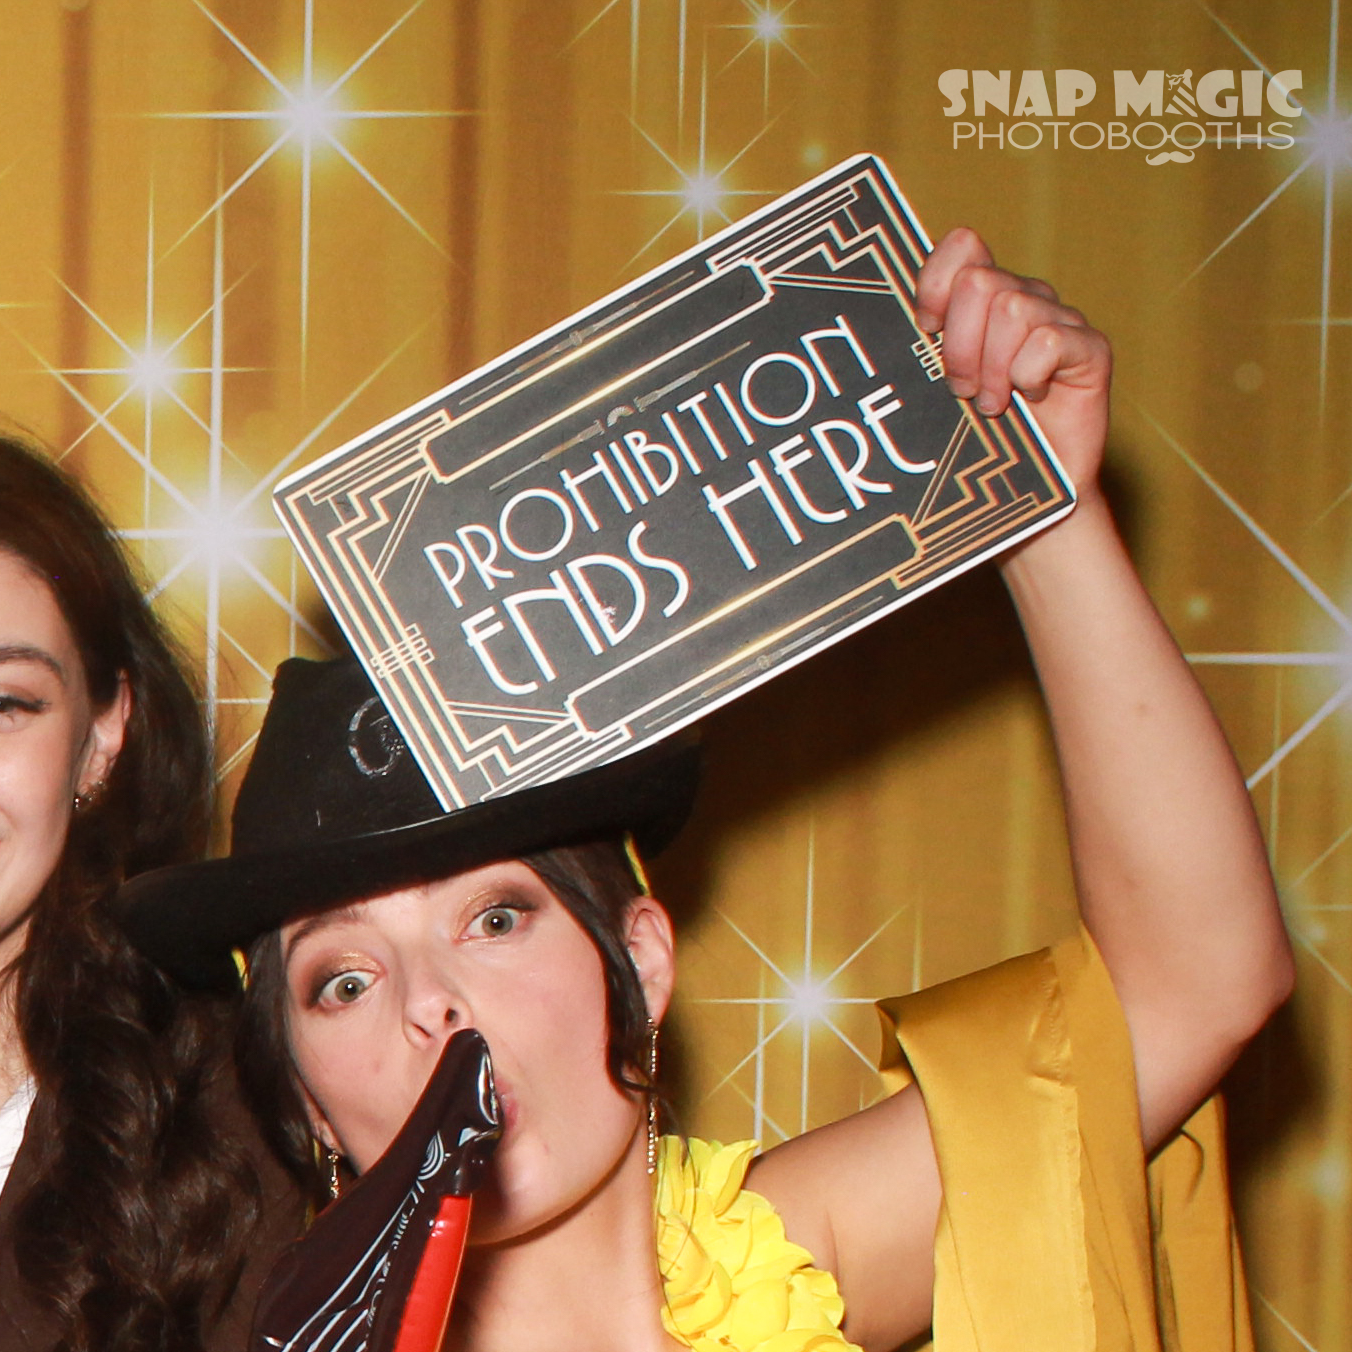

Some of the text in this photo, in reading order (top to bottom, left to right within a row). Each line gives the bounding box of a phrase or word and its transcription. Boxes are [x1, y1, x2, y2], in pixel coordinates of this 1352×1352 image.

[422, 315, 877, 610] PROHIBITION
[460, 382, 937, 697] ENDS HERE
